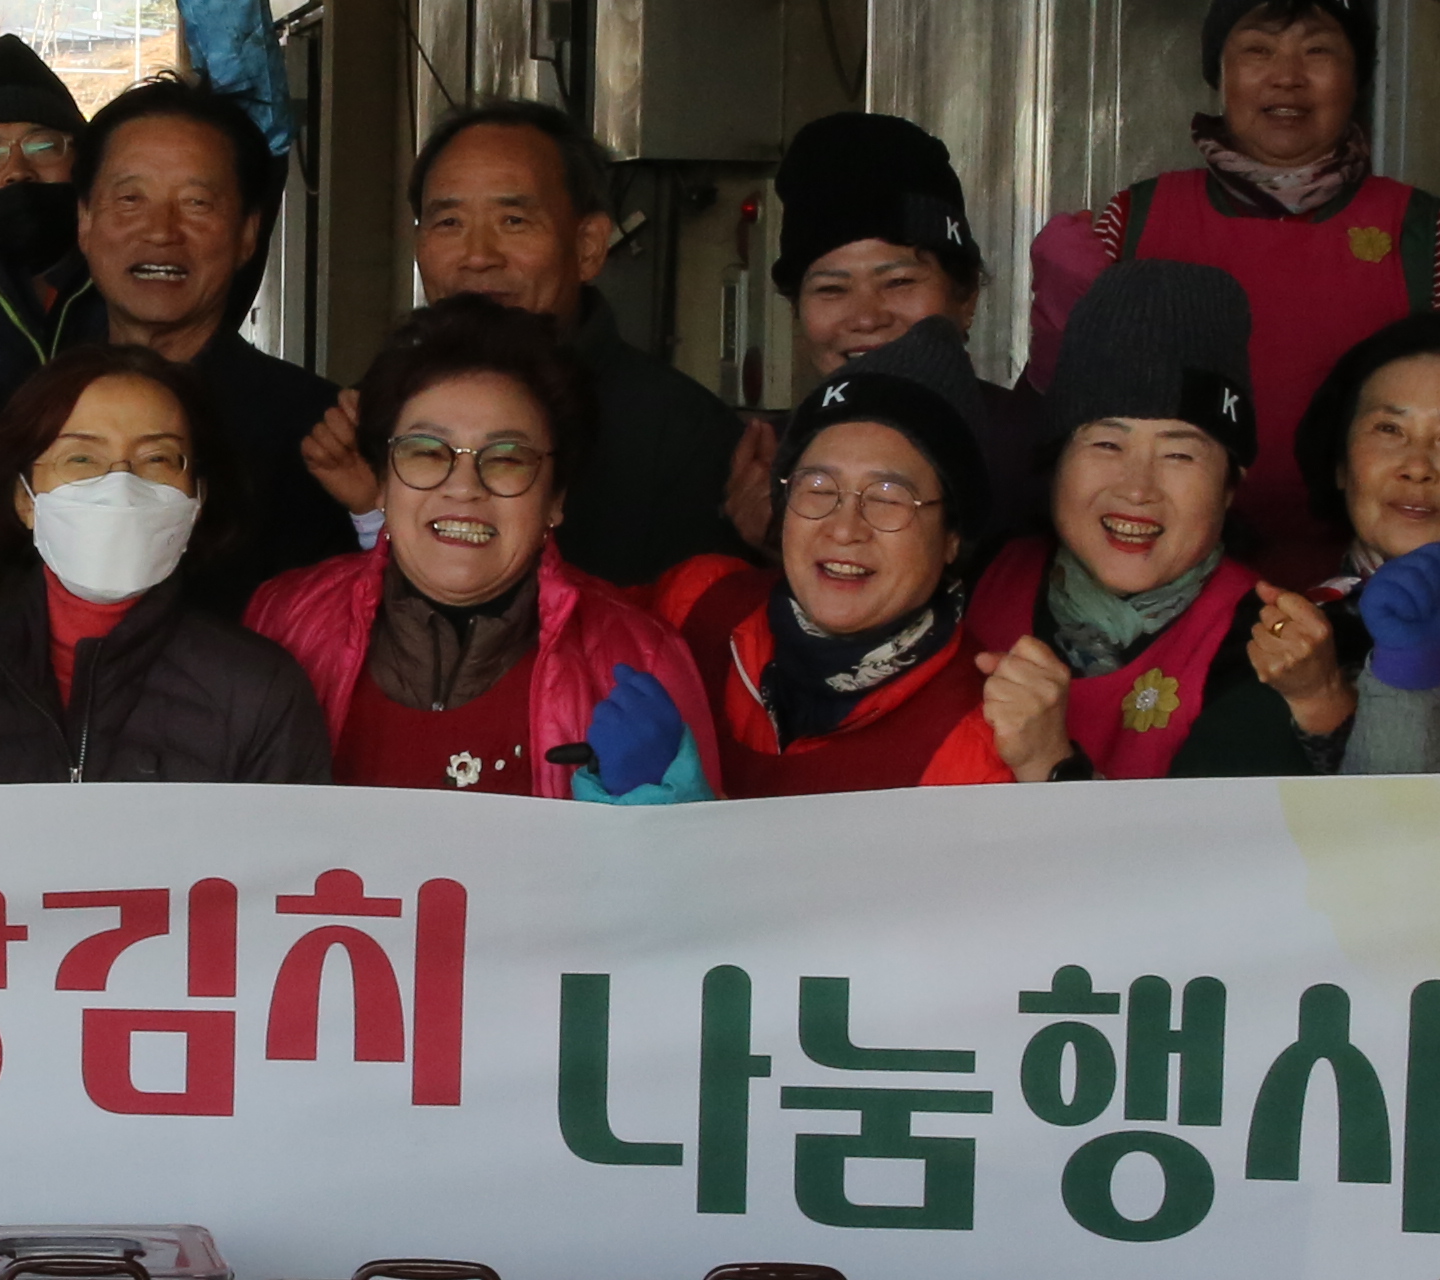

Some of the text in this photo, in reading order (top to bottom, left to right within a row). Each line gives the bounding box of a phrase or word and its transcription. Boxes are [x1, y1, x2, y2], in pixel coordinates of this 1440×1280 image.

[946, 215, 961, 245] K
[822, 382, 849, 406] K
[1222, 387, 1238, 422] K
